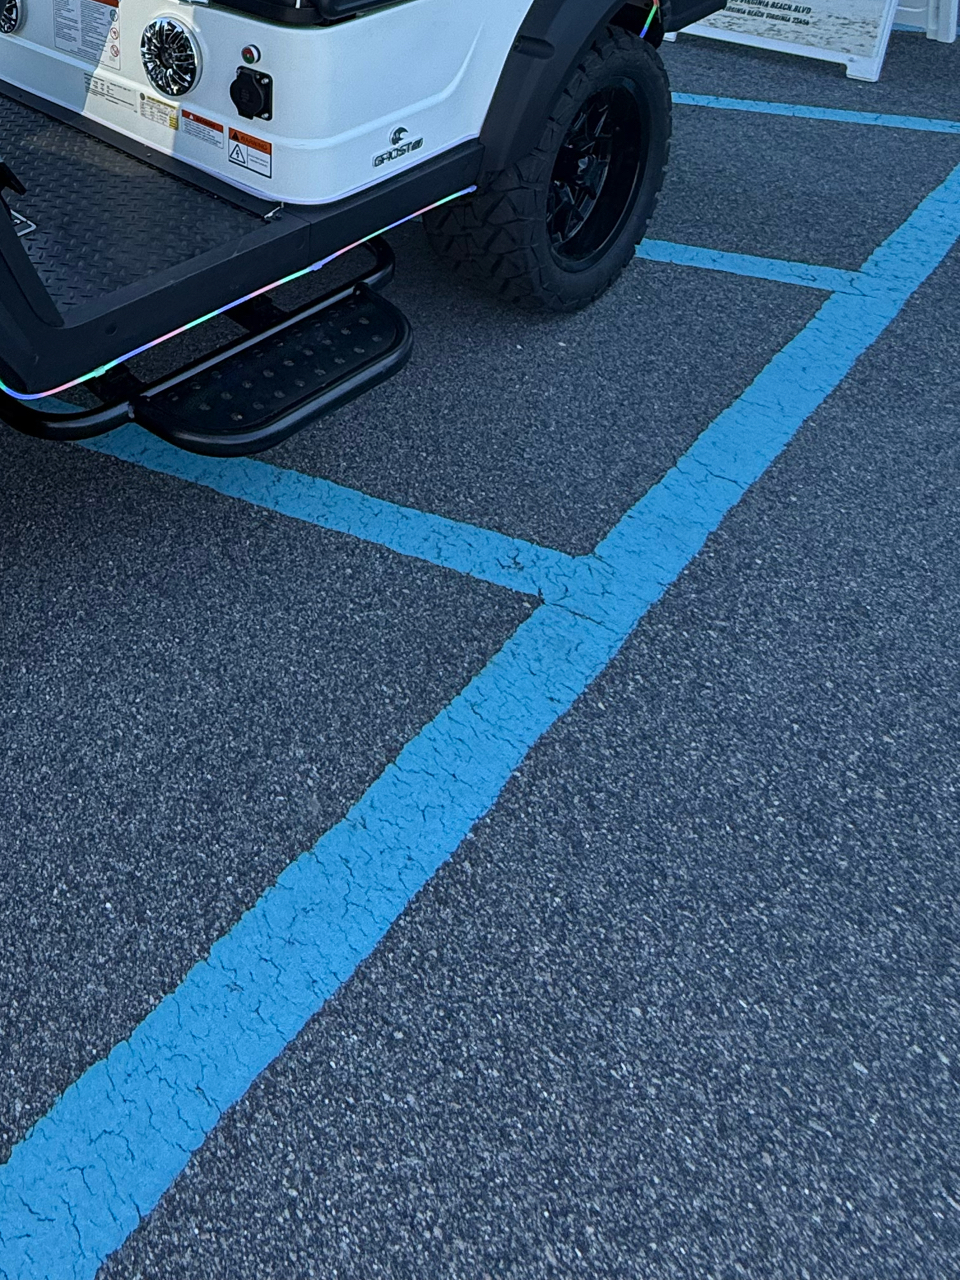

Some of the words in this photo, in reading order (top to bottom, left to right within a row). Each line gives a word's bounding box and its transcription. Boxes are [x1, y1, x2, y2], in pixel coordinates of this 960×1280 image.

[725, 6, 746, 15] IRGINIA
[747, 9, 765, 18] BEACH
[765, 12, 791, 22] VIRGINIA
[770, 2, 792, 12] BEACH
[792, 5, 812, 15] BLVD
